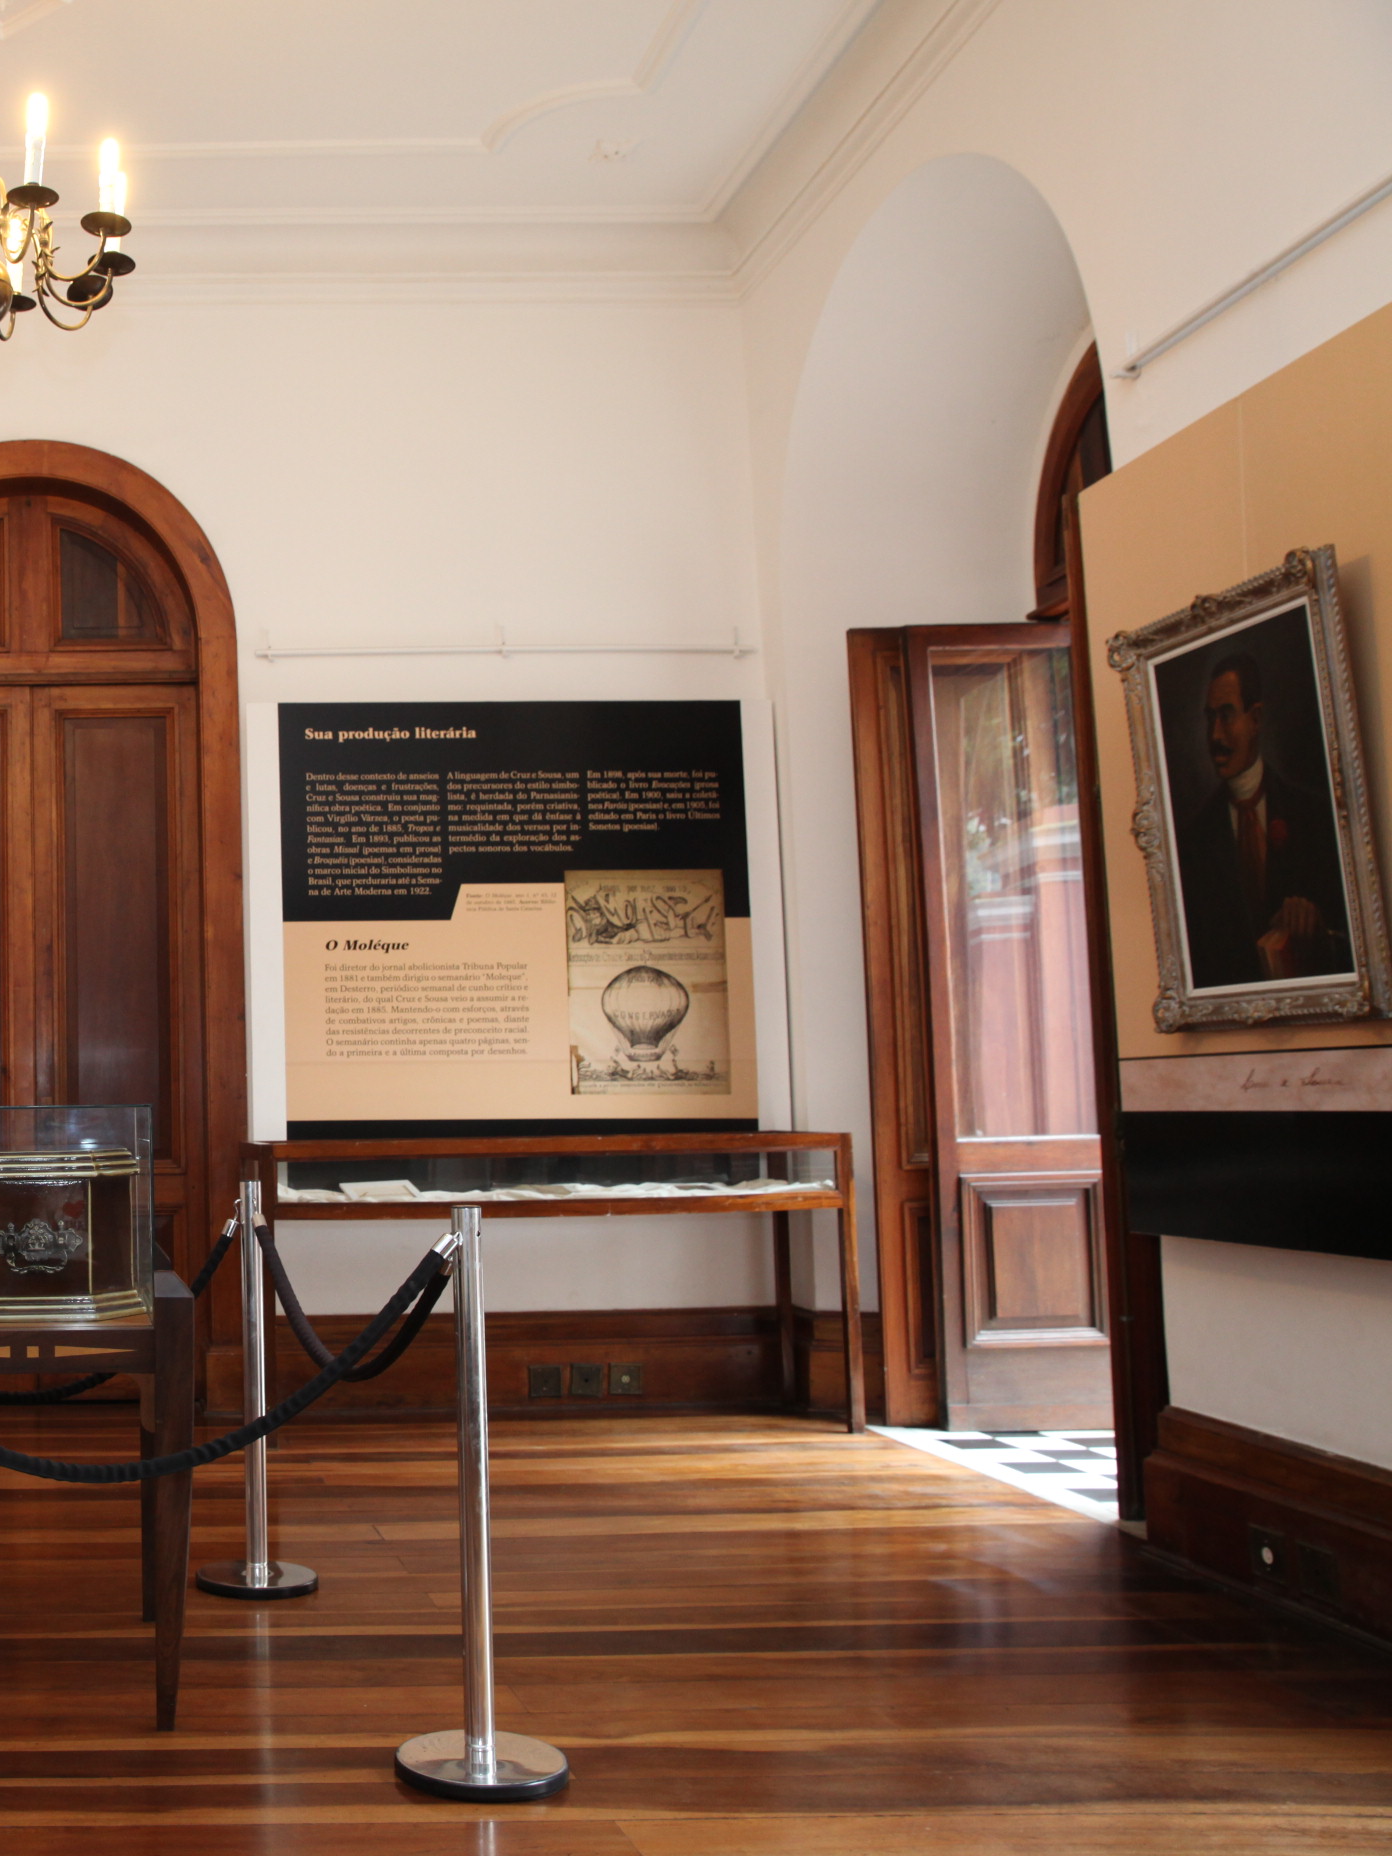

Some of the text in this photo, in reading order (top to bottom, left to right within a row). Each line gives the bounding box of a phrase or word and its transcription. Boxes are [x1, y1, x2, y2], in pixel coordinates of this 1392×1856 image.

[305, 727, 477, 742] Sua produção literária
[325, 940, 338, 951] O
